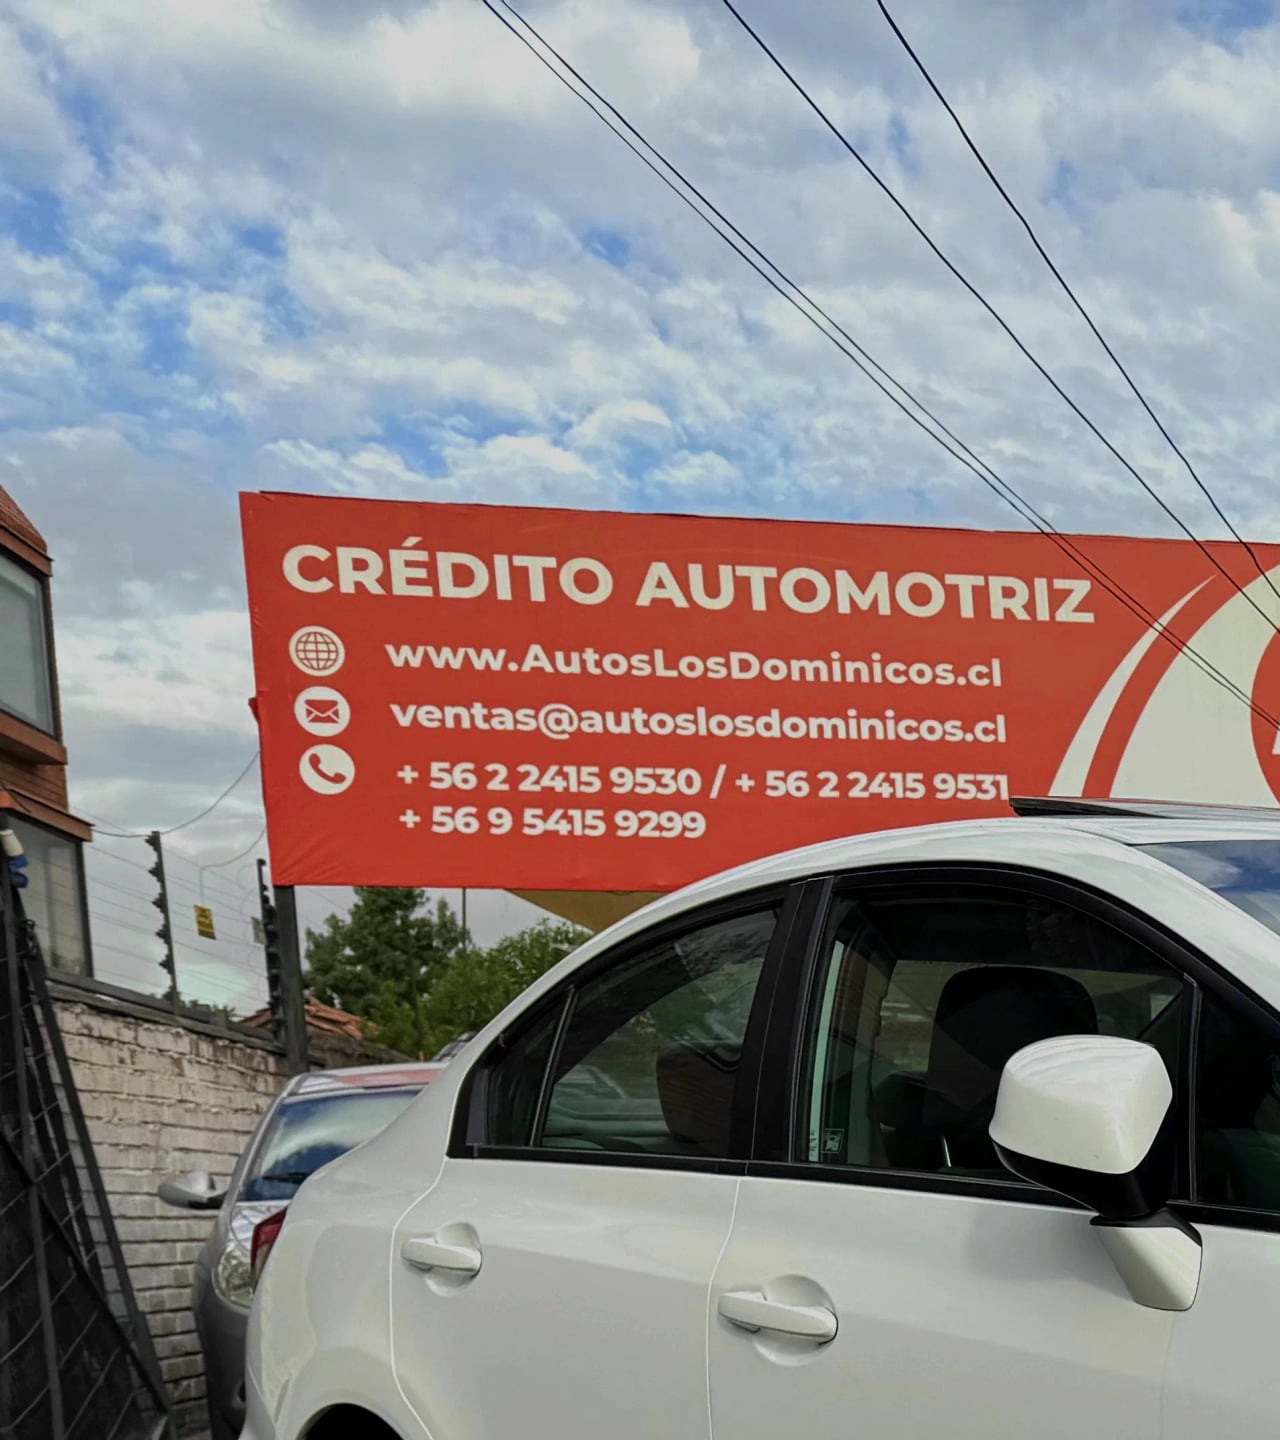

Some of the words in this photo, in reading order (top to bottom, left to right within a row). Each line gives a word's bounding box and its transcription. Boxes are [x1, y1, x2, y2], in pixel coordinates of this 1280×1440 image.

[282, 537, 614, 606] CRÉDITO
[635, 561, 1095, 624] AUTOMOTRIZ
[384, 640, 1002, 688] www.AutosLosDominicos.cl
[389, 700, 1007, 744] ventas@autoslosdominicos.cl
[398, 764, 419, 785] +
[429, 761, 478, 790] 56
[484, 762, 510, 791] 2
[516, 763, 602, 794] 2415
[609, 766, 702, 796] 9530
[709, 763, 727, 800] /
[735, 773, 756, 793] +
[764, 769, 811, 798] 56
[816, 770, 840, 798] 2
[846, 771, 926, 800] 2415
[932, 772, 1009, 801] 9531
[399, 809, 421, 829] +
[431, 805, 480, 835] 56
[487, 806, 513, 835] 9
[522, 807, 607, 837] 5415
[613, 809, 707, 839] 9299
